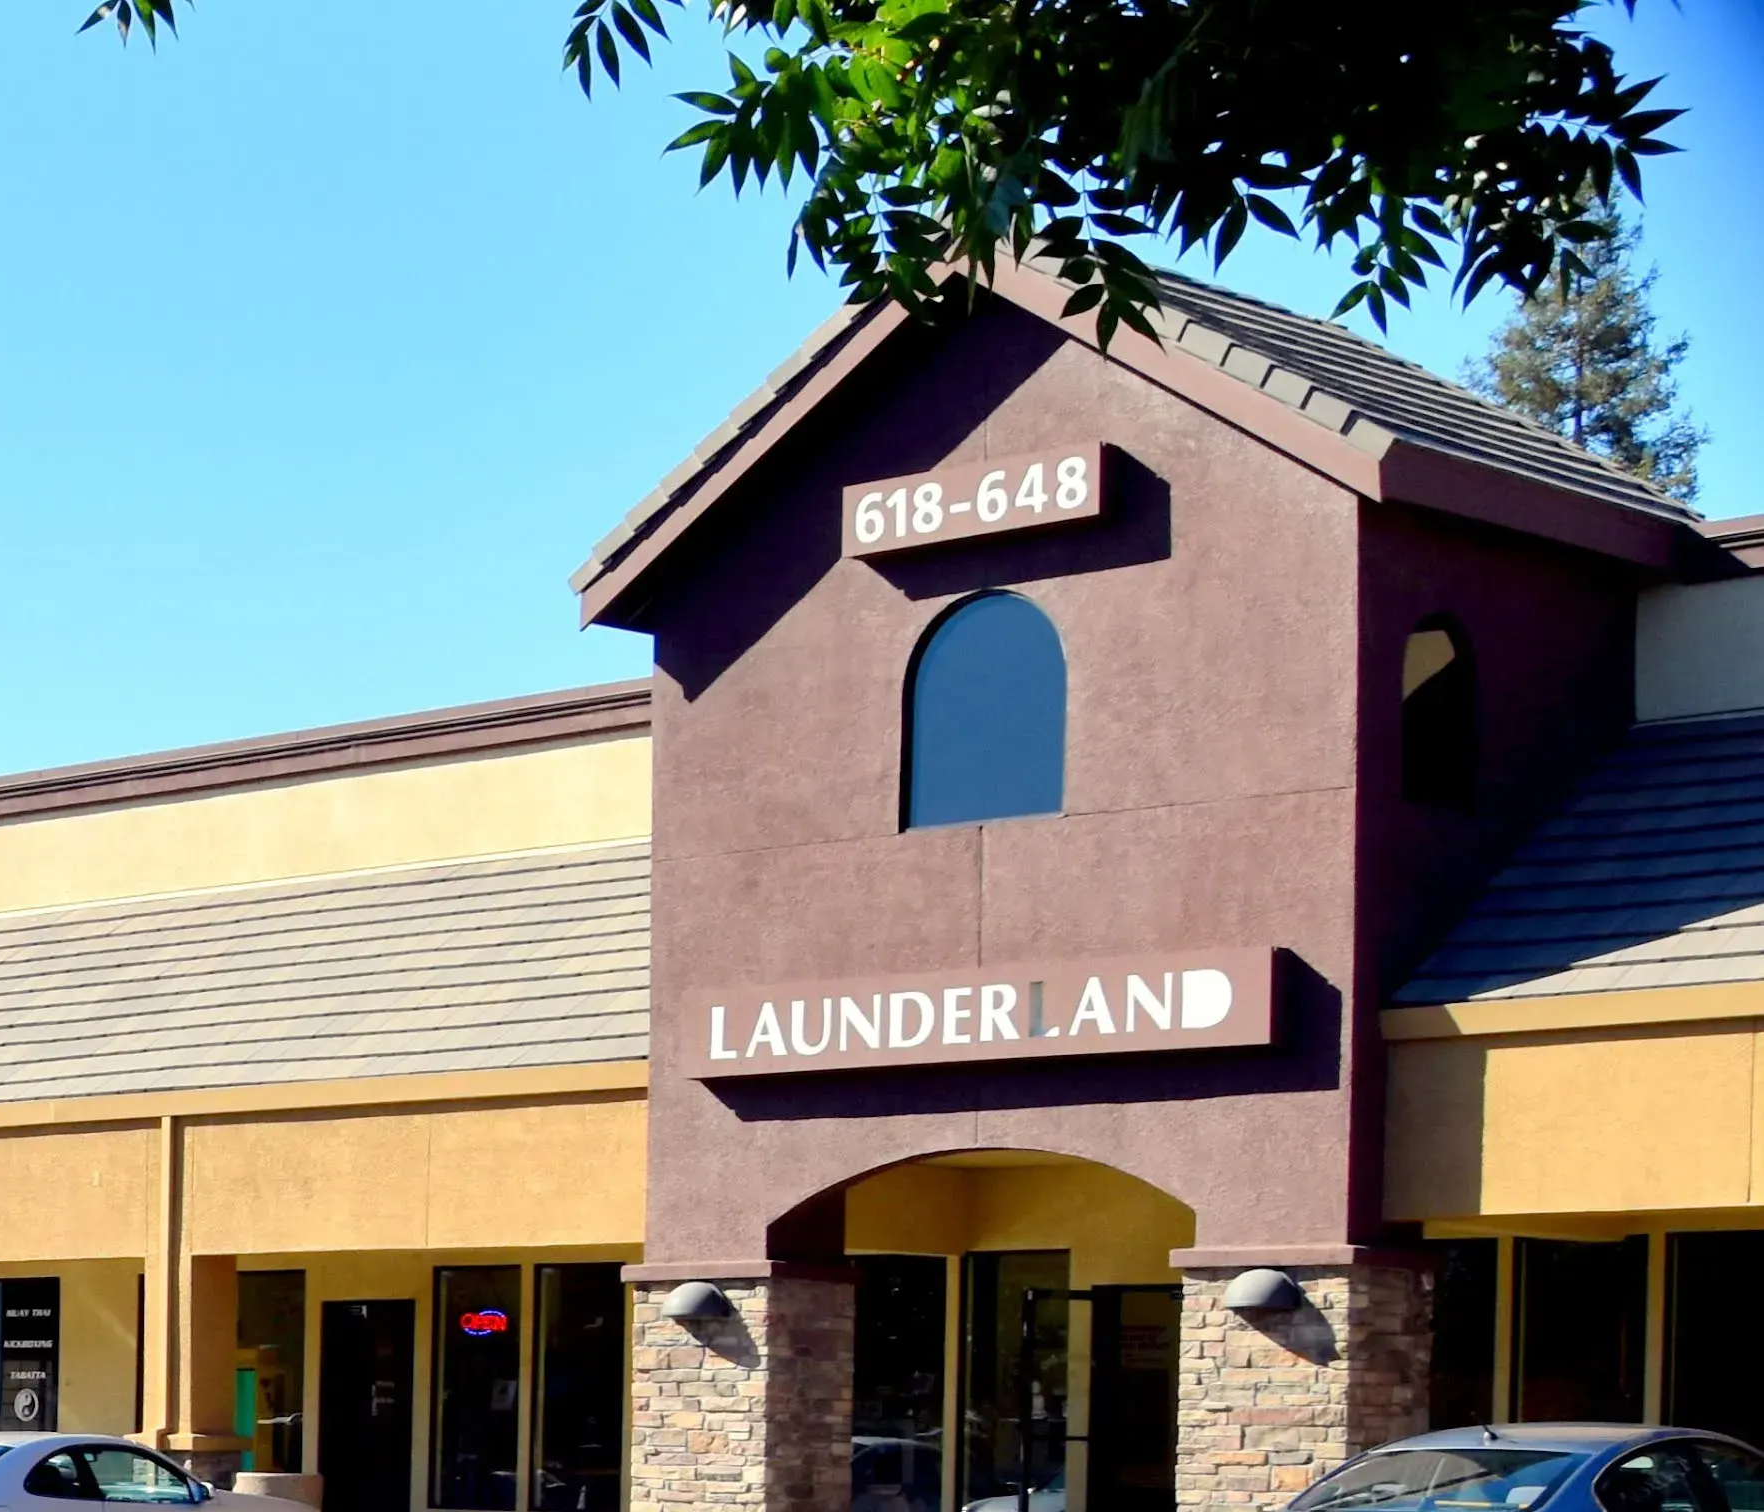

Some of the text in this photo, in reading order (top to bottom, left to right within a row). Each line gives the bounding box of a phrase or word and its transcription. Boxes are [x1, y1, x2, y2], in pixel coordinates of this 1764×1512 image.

[855, 456, 1089, 543] 618-648
[709, 968, 1234, 1061] LAUNDERLAND
[461, 1313, 507, 1331] OPEN
